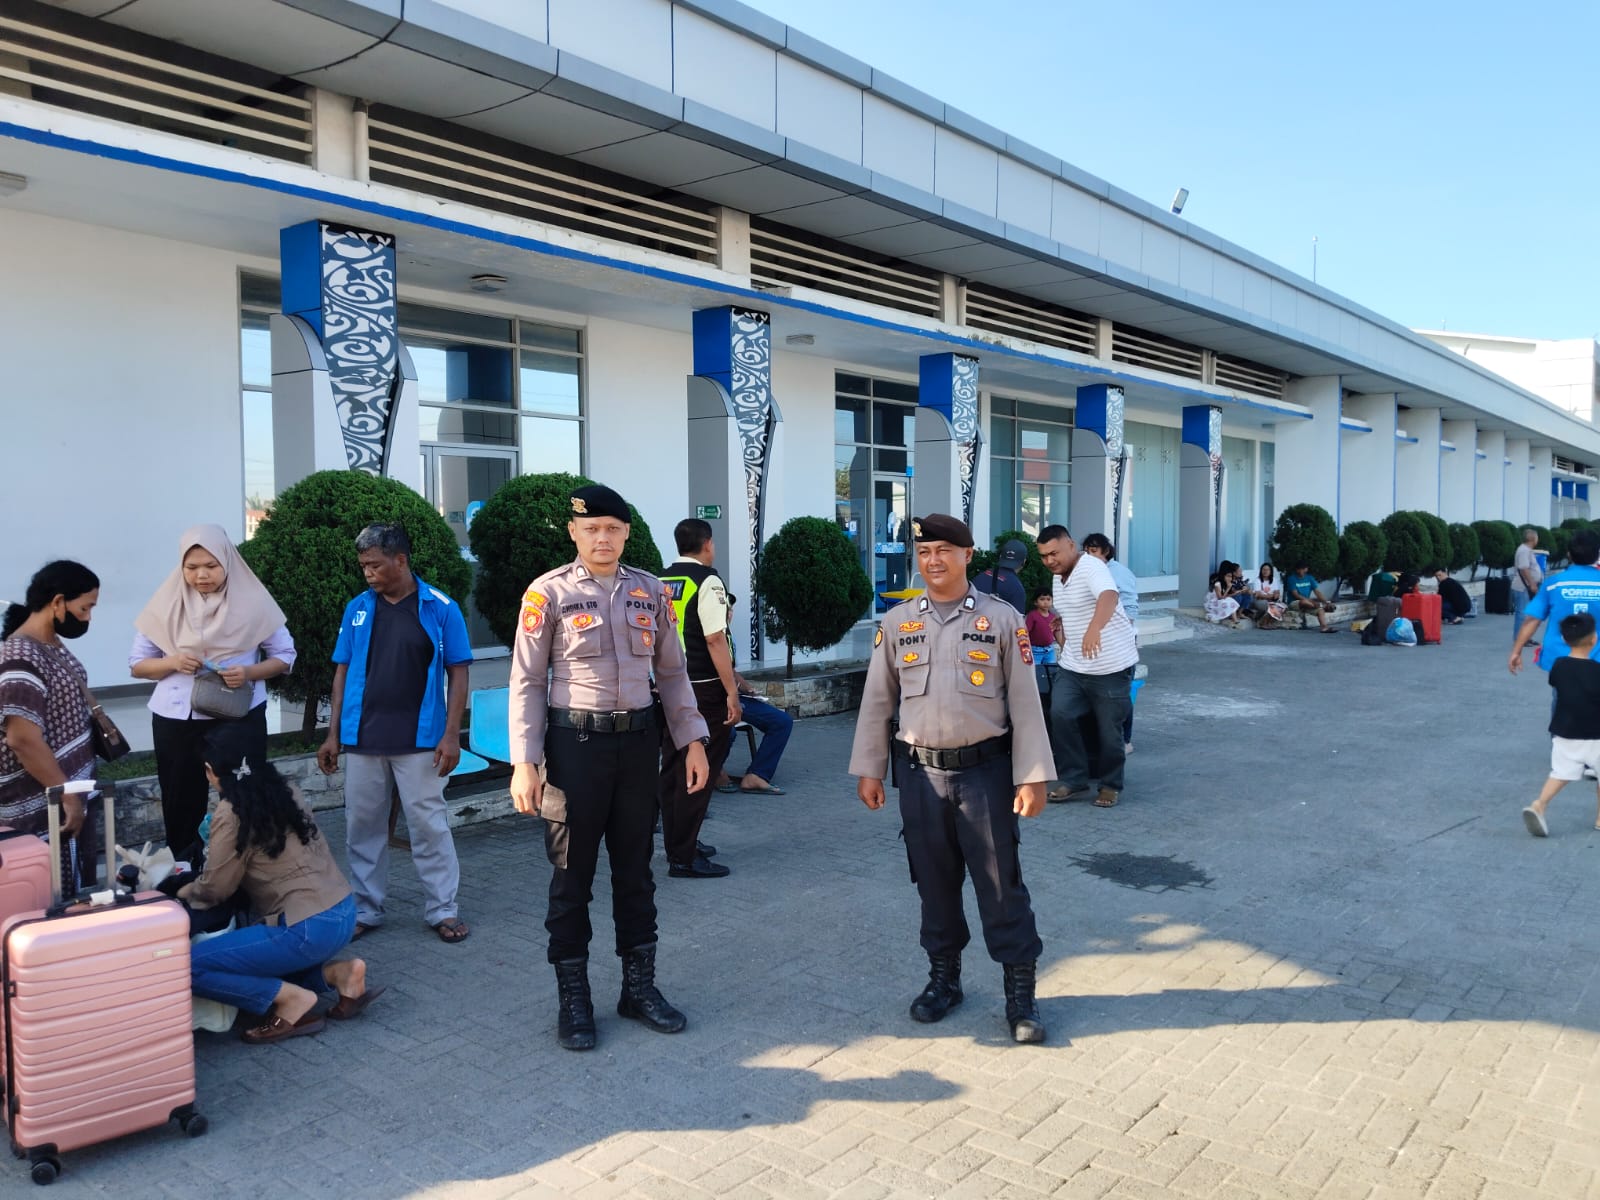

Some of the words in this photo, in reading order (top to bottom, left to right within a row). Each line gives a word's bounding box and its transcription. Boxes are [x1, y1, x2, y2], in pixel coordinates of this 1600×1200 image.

[626, 600, 656, 612] POLRI
[899, 634, 926, 646] DONY
[962, 633, 996, 644] POLRI
